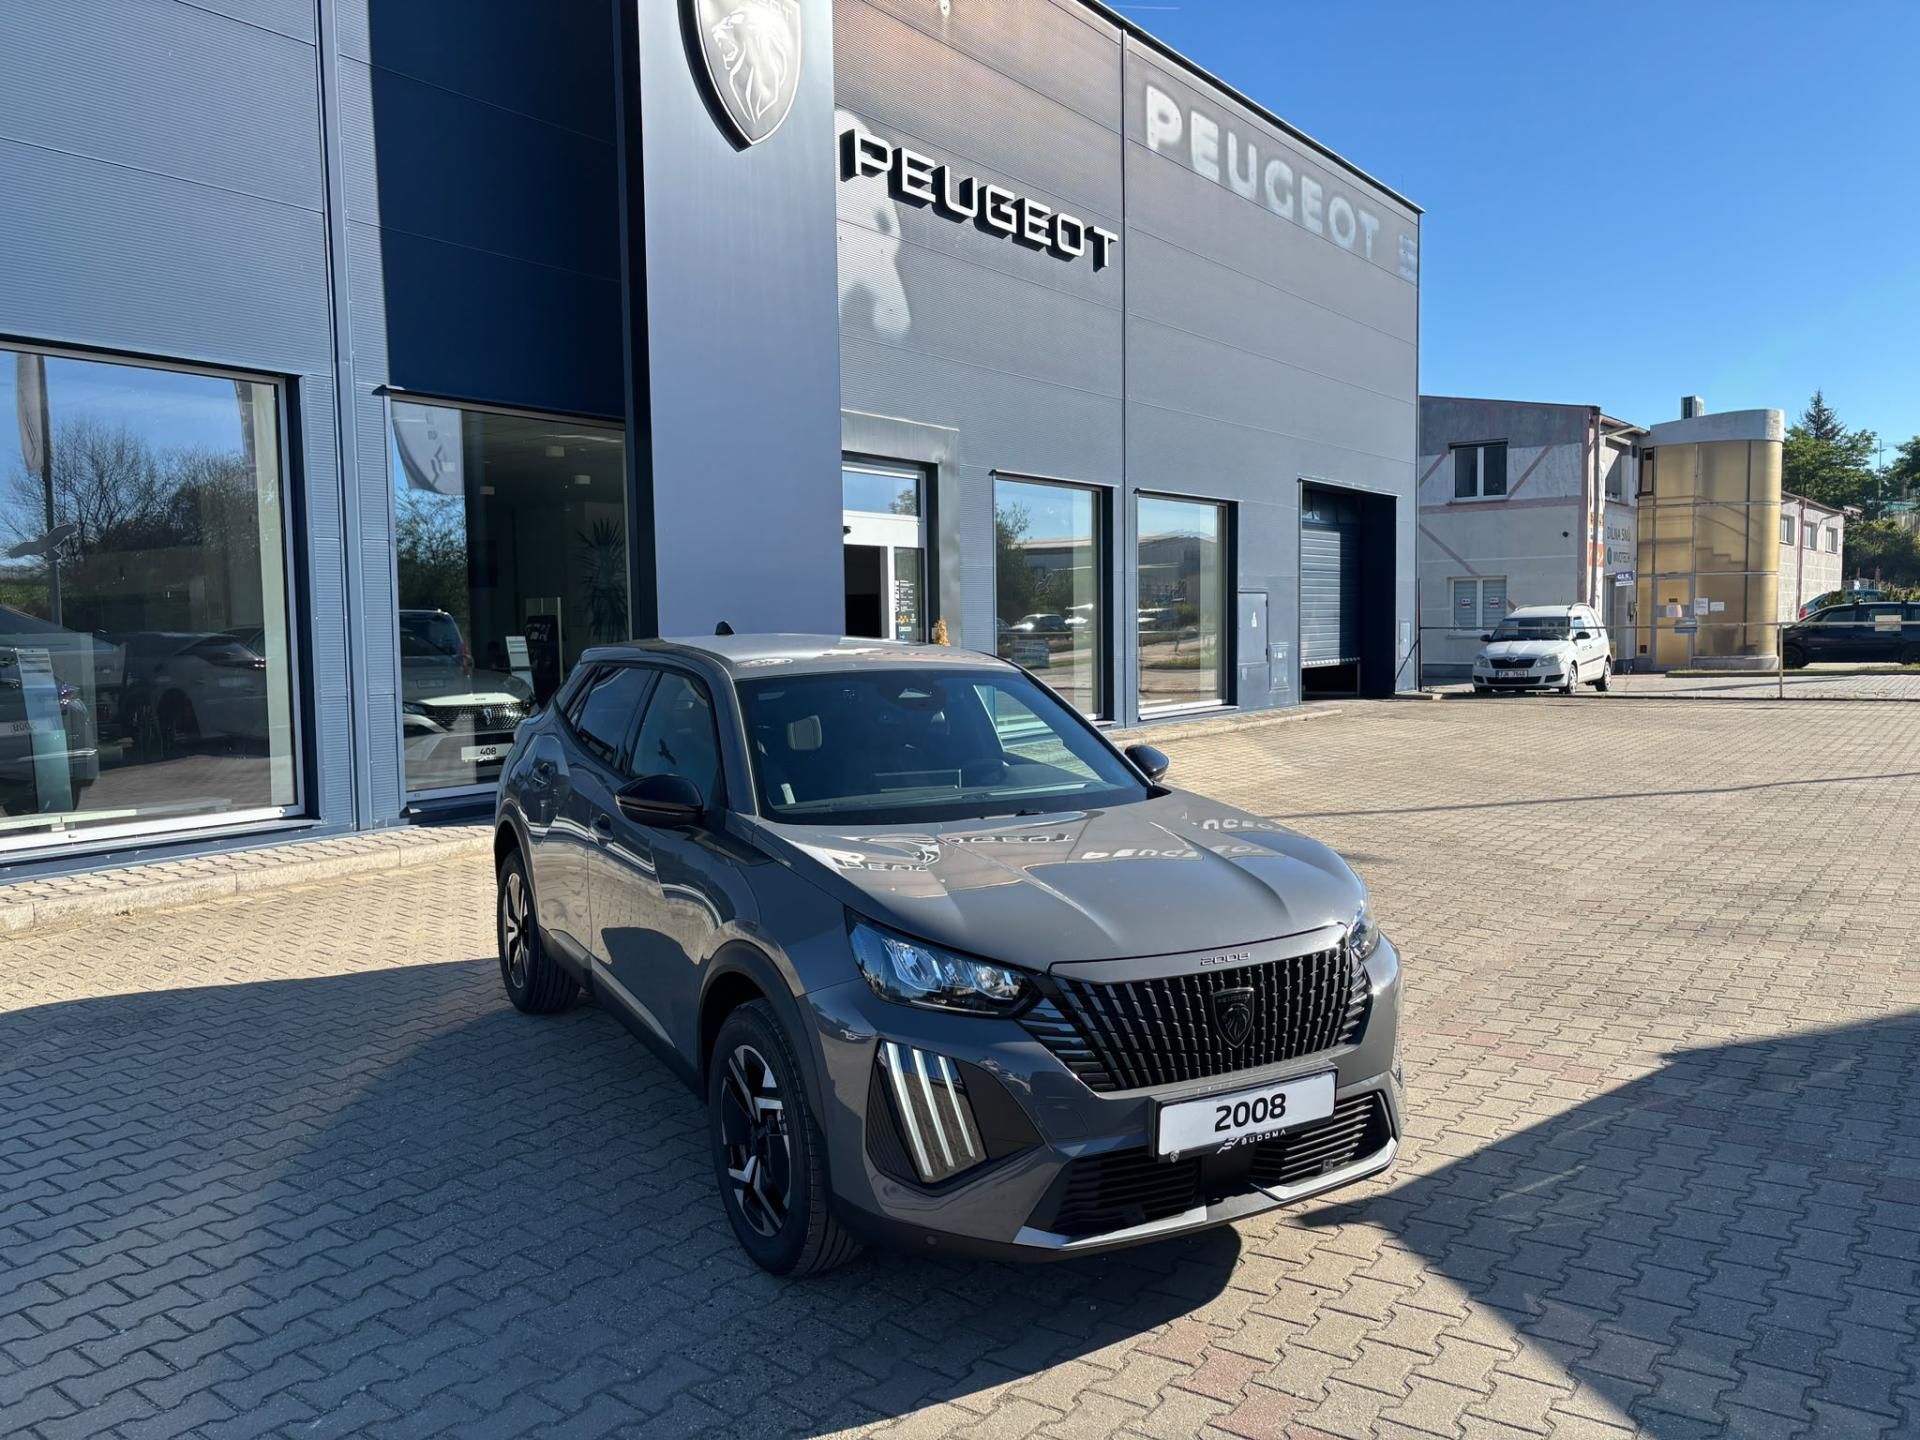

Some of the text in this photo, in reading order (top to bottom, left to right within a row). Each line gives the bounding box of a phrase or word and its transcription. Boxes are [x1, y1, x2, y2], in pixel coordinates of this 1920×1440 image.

[1146, 84, 1380, 259] PEUGEOT
[841, 128, 1118, 271] PEUGEOT
[480, 747, 497, 755] 408
[1201, 952, 1250, 967] 2008
[1214, 1093, 1287, 1132] 2008
